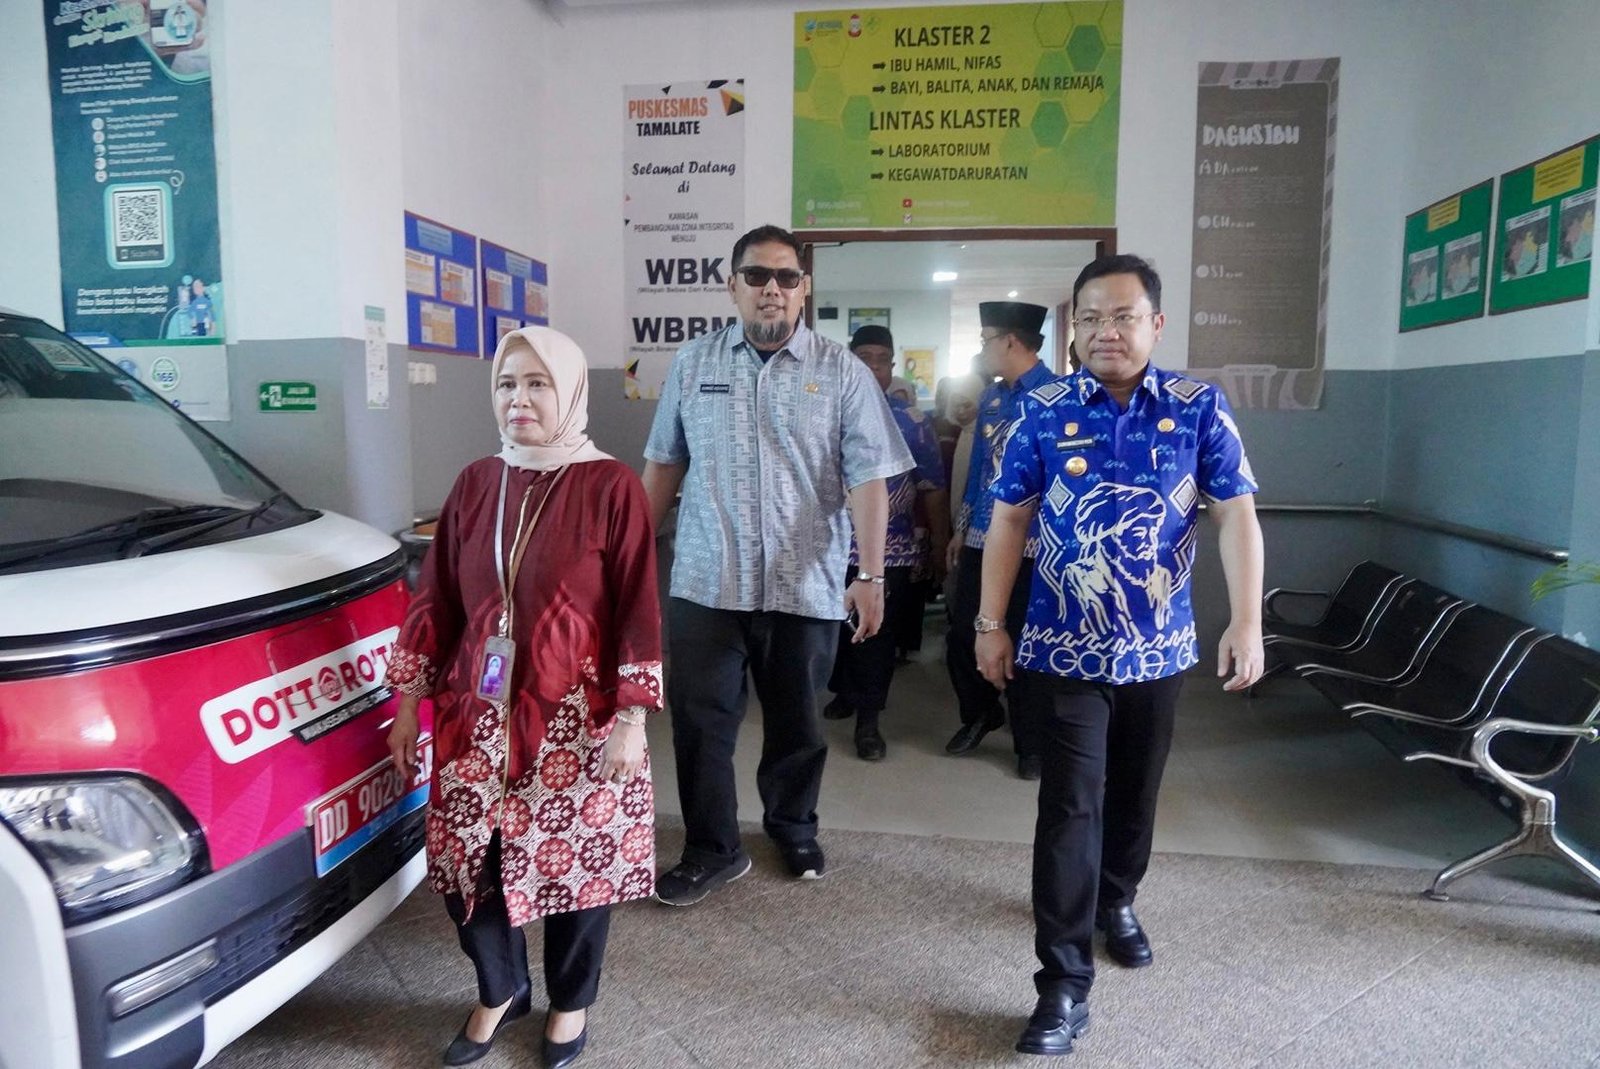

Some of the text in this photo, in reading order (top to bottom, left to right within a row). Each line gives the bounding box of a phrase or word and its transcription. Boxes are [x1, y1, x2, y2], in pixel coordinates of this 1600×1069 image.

[895, 25, 991, 47] KLASTER 2
[890, 56, 1001, 72] IBU HAMIL, NIFAS
[890, 75, 1104, 97] BAYI, BALITA, ANAK, DAN REMAJA
[628, 97, 709, 119] PUSKESMAS
[637, 121, 701, 136] TAMALATE
[869, 108, 1021, 131] LINTAS KLASTER
[889, 142, 991, 158] LABORATORIUM
[632, 161, 736, 176] Selamat Datang
[888, 165, 1029, 182] KEGAWATDARURATAN
[677, 180, 690, 193] di
[644, 257, 725, 285] WBK
[220, 642, 396, 747] DOTTORO'T
[319, 799, 349, 850] DD
